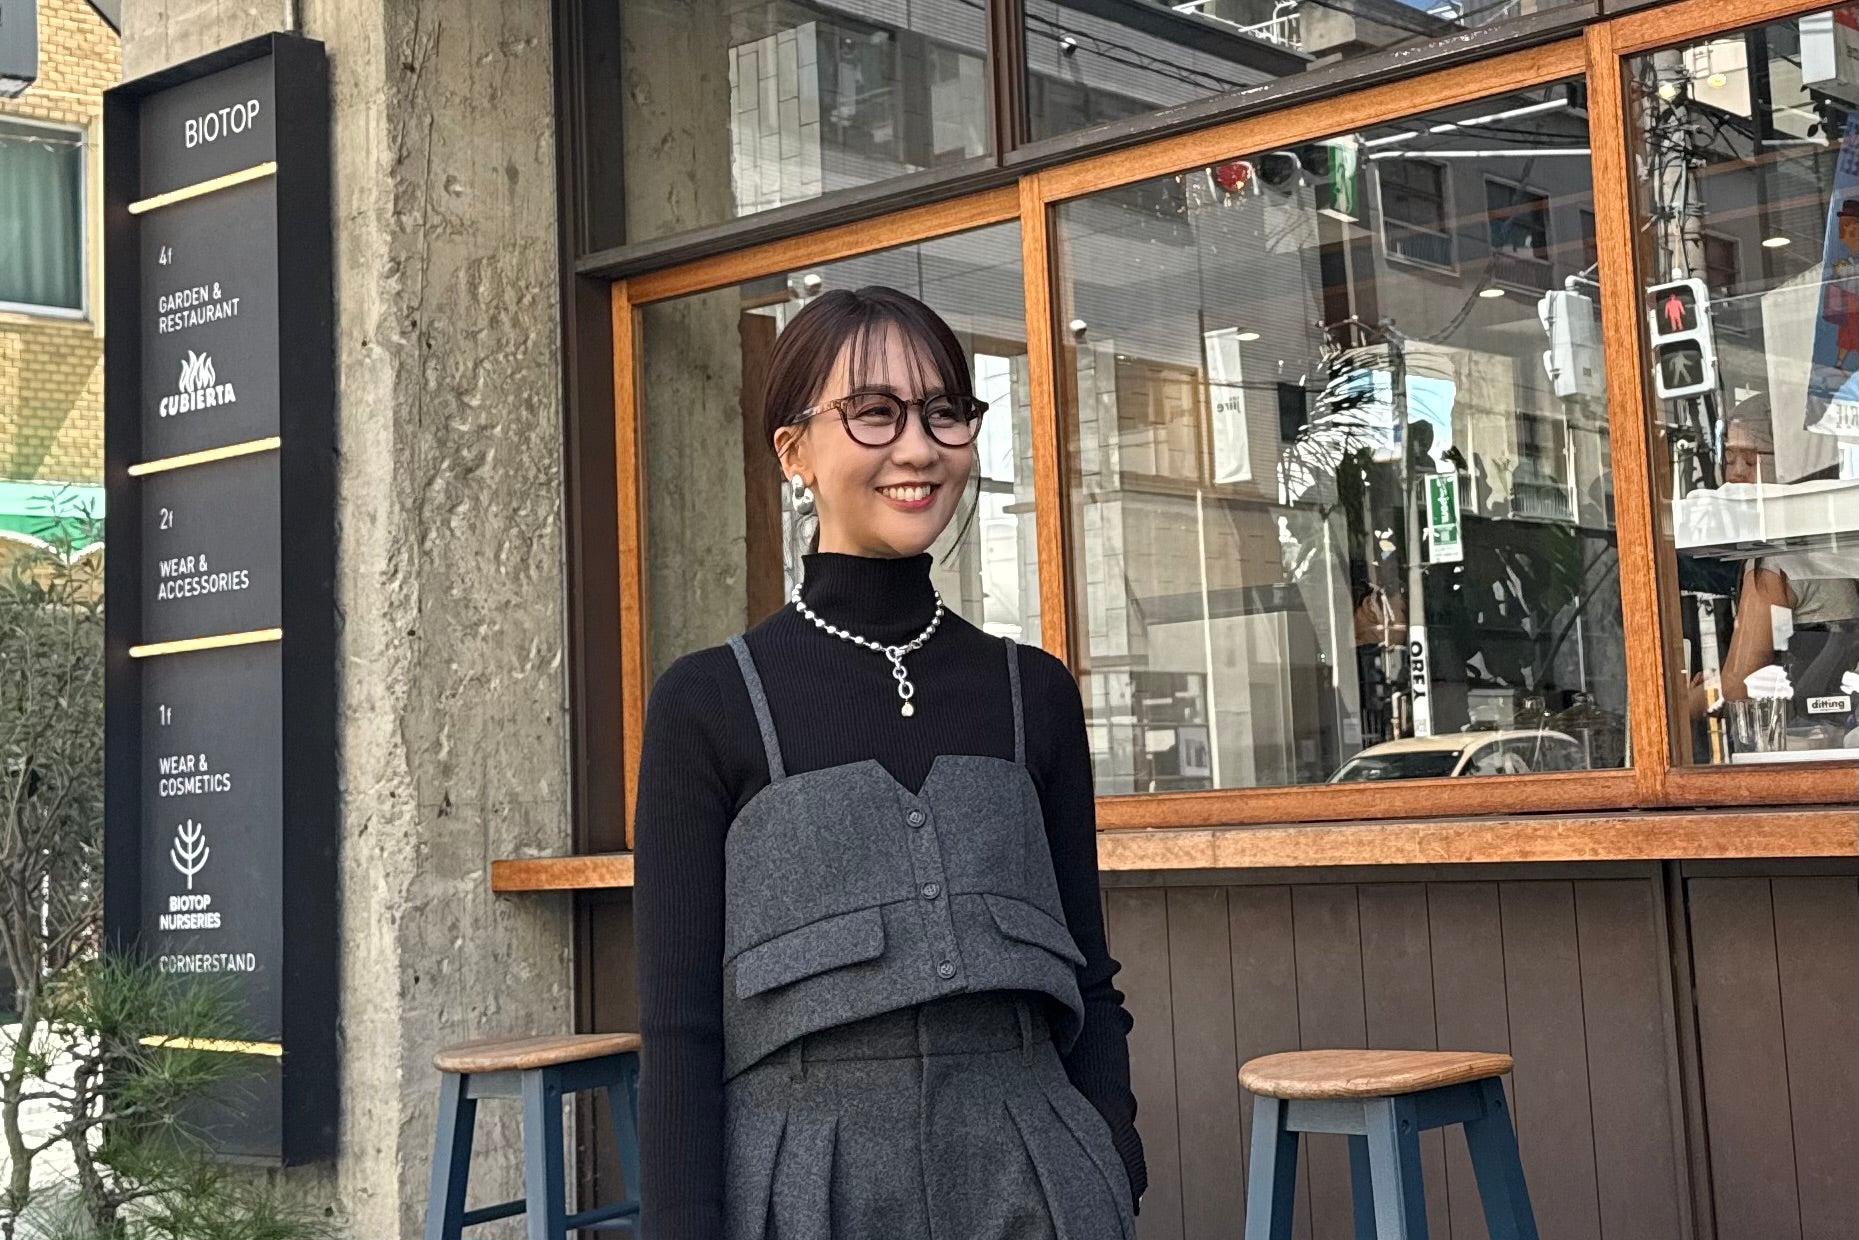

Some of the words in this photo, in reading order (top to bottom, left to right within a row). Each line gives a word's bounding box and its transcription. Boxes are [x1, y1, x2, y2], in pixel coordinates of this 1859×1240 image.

[185, 99, 260, 149] BIOTOP
[159, 246, 172, 265] 4f
[159, 285, 209, 313] GARDEN
[212, 282, 222, 300] &
[159, 297, 240, 334] RESTAURANT
[159, 382, 237, 418] CUBIERTA
[159, 507, 174, 530] 2f
[159, 555, 196, 578] WEAR
[198, 553, 208, 572] &
[158, 569, 250, 601] ACCESSORIES
[159, 704, 172, 726] 1f
[1811, 699, 1845, 710] ditting
[159, 754, 196, 775] WEAR
[198, 753, 208, 772] &
[159, 772, 232, 797] COSMETICS
[169, 893, 212, 912] BIOTOP
[159, 911, 222, 931] NURSERIES
[159, 952, 256, 973] CORNERSTAND
